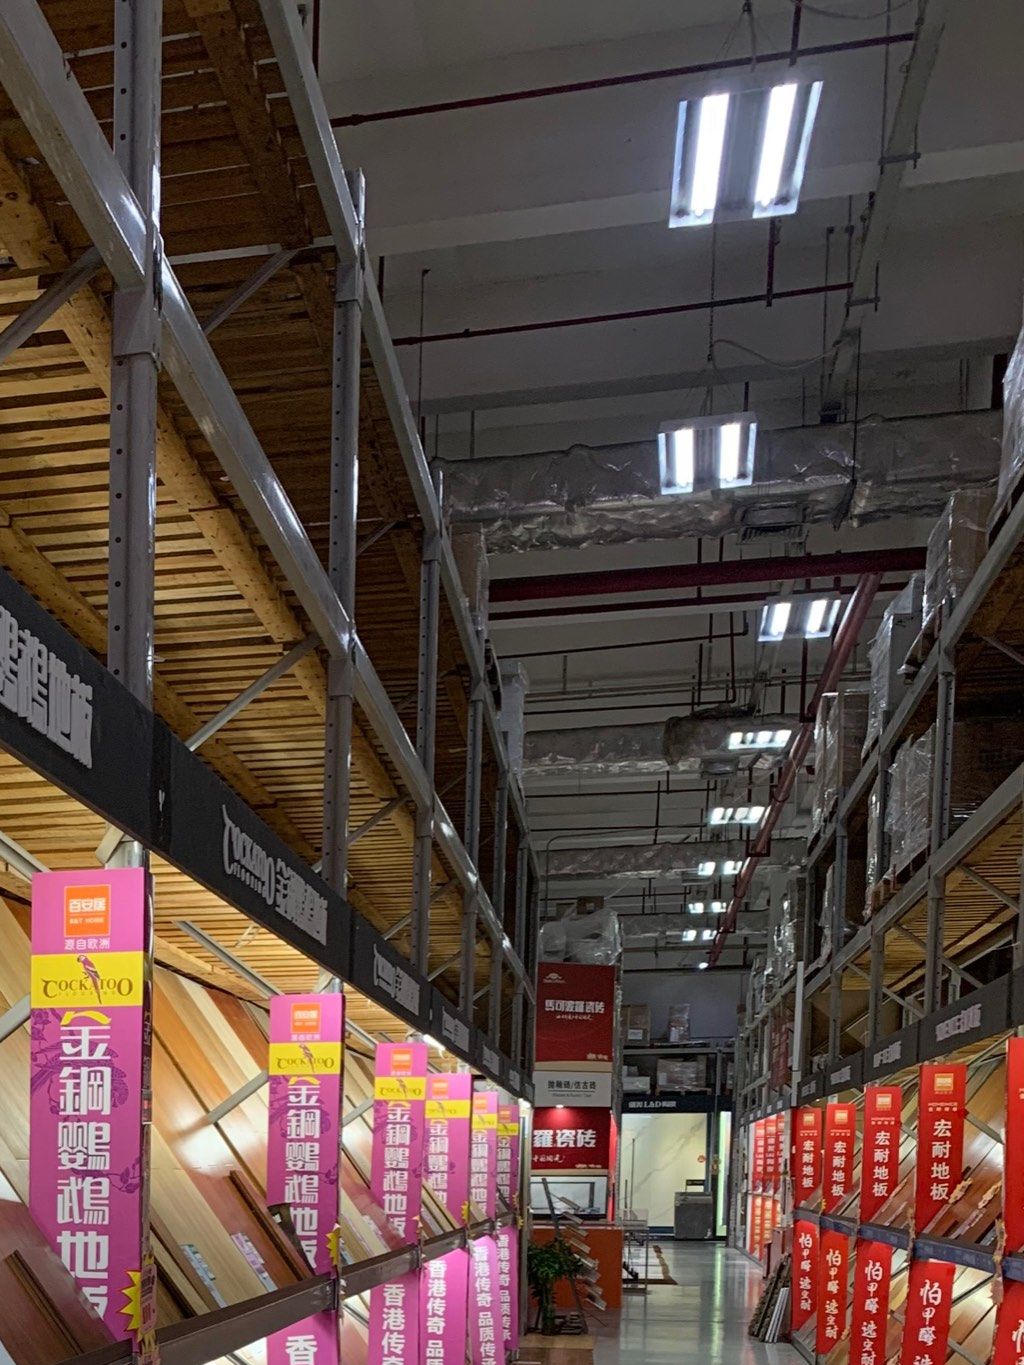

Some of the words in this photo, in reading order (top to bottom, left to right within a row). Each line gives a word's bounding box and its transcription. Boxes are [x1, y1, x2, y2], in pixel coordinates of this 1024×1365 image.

[872, 1130, 891, 1198] 宏耐地板
[930, 1118, 953, 1201] 宏耐地板
[426, 1260, 448, 1335] 香港传奇
[864, 1260, 883, 1314] 怕甲醛
[917, 1280, 942, 1346] 怕甲醛
